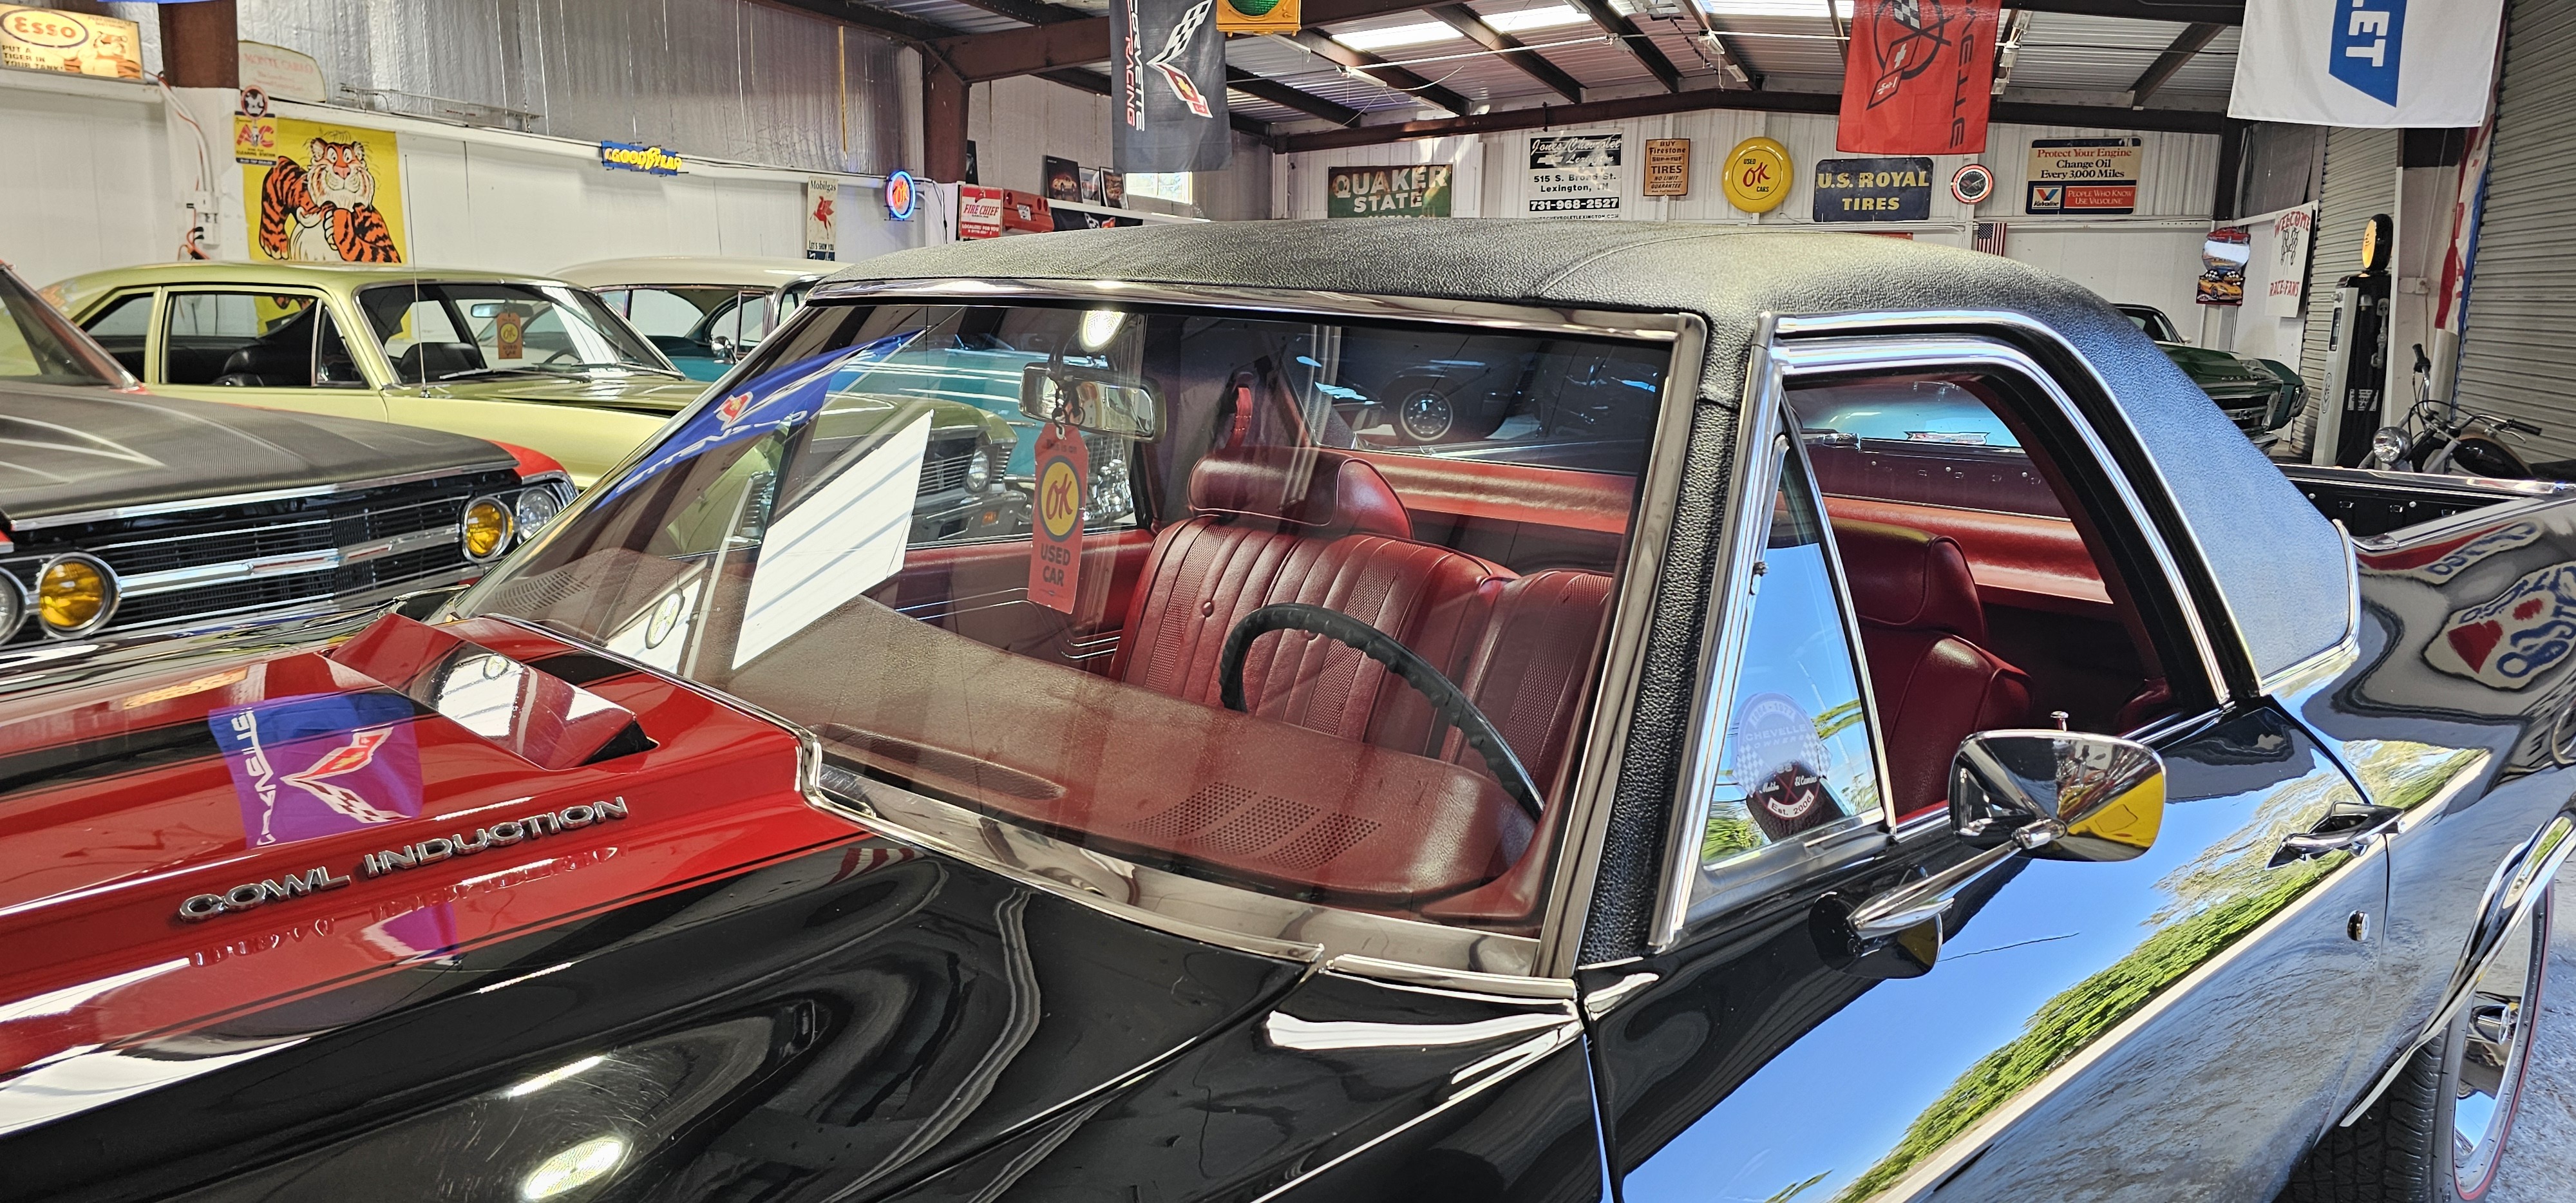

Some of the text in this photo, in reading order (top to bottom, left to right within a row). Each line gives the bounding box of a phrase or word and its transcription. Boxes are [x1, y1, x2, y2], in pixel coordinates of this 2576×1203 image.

[2345, 0, 2390, 67] ET
[4, 52, 32, 61] TIGER
[5, 61, 31, 69] YOUR
[1125, 0, 1135, 126] RACING
[1531, 136, 1622, 156] Jones Chevrolet
[2037, 147, 2132, 158] Protect Your Engine
[604, 147, 683, 169] GOODYEAR
[1566, 154, 1615, 166] Lexington
[2056, 158, 2111, 169] Change Oil
[1569, 173, 1598, 182] Broad
[1651, 165, 1682, 174] TIRES
[1743, 162, 1771, 187] OK
[2041, 169, 2125, 180] Every 3,000 Miles
[810, 180, 837, 193] Mobilgas
[1332, 166, 1448, 198] QUAKER
[1817, 171, 1929, 188] U.S. ROYAL
[1540, 184, 1592, 193] Lexington,
[964, 204, 999, 216] FIRE CHIEF
[1354, 193, 1423, 213] STATE
[1530, 198, 1618, 211] 731-968-2527
[1842, 197, 1900, 211] TIRES
[2274, 210, 2311, 238] WELCOME
[819, 242, 828, 251] SHOW
[1046, 473, 1074, 520] OK
[1040, 543, 1071, 566] USED
[1042, 565, 1065, 587] CAR
[1745, 723, 1806, 741] CHEVELLE
[1772, 795, 1812, 816] Est. 2006
[179, 796, 629, 923] COWL INDUCTION
